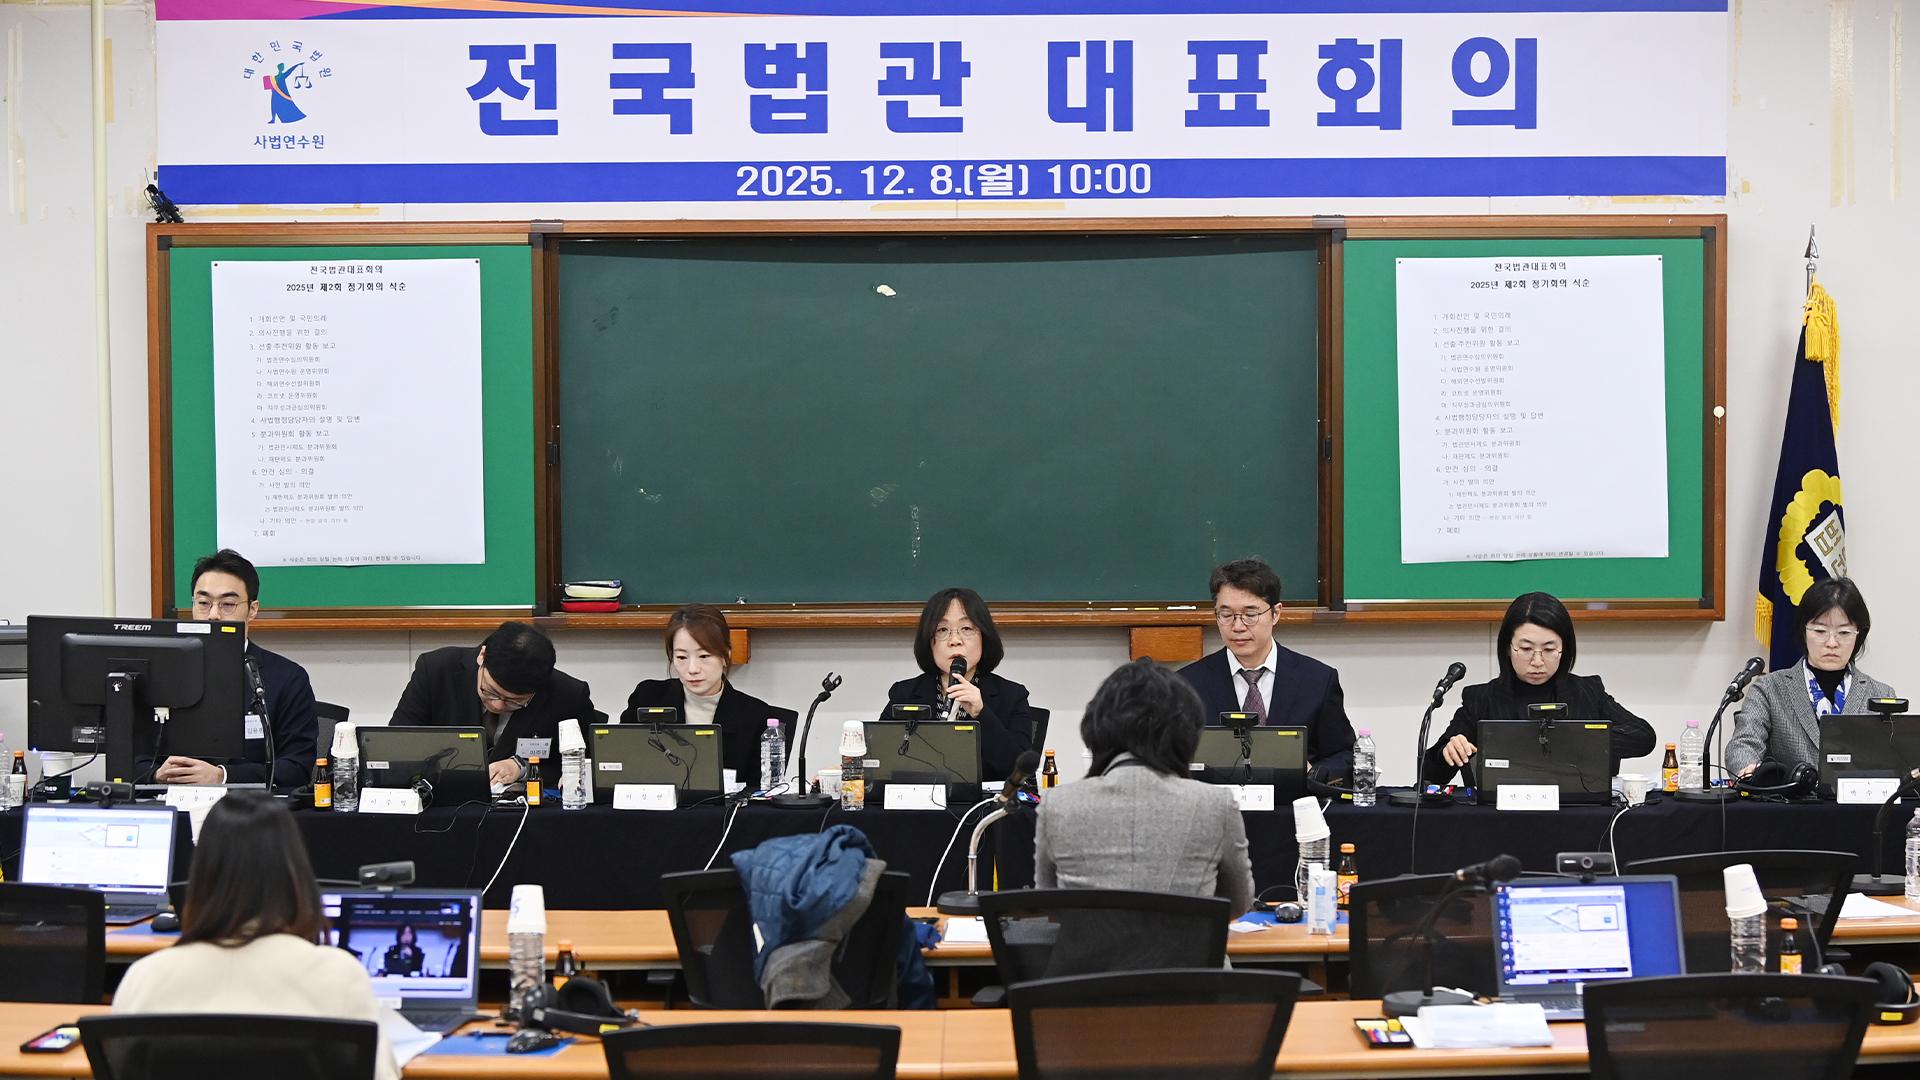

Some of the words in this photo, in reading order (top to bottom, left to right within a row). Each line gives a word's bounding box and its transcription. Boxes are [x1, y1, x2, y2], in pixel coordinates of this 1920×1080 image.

[467, 41, 972, 137] 전국법관
[1047, 37, 1538, 133] 대표회의
[253, 134, 325, 150] 사법연수원
[736, 165, 842, 196] 2025.
[860, 165, 914, 195] 12.
[930, 163, 1029, 196] 8.(월)
[1047, 163, 1151, 194] 10:00
[310, 265, 383, 275] 전국법관대표회의
[1494, 262, 1566, 272] 전국법관대표회의
[286, 282, 314, 293] 2025년
[320, 282, 342, 293] 제2회
[347, 281, 383, 292] 정기회의
[389, 281, 406, 292] 식순
[1470, 280, 1499, 290] 2025년
[1504, 279, 1527, 290] 제2회
[1532, 279, 1568, 289] 정기회의
[1573, 278, 1590, 289] 식순
[113, 623, 152, 632] TREEM
